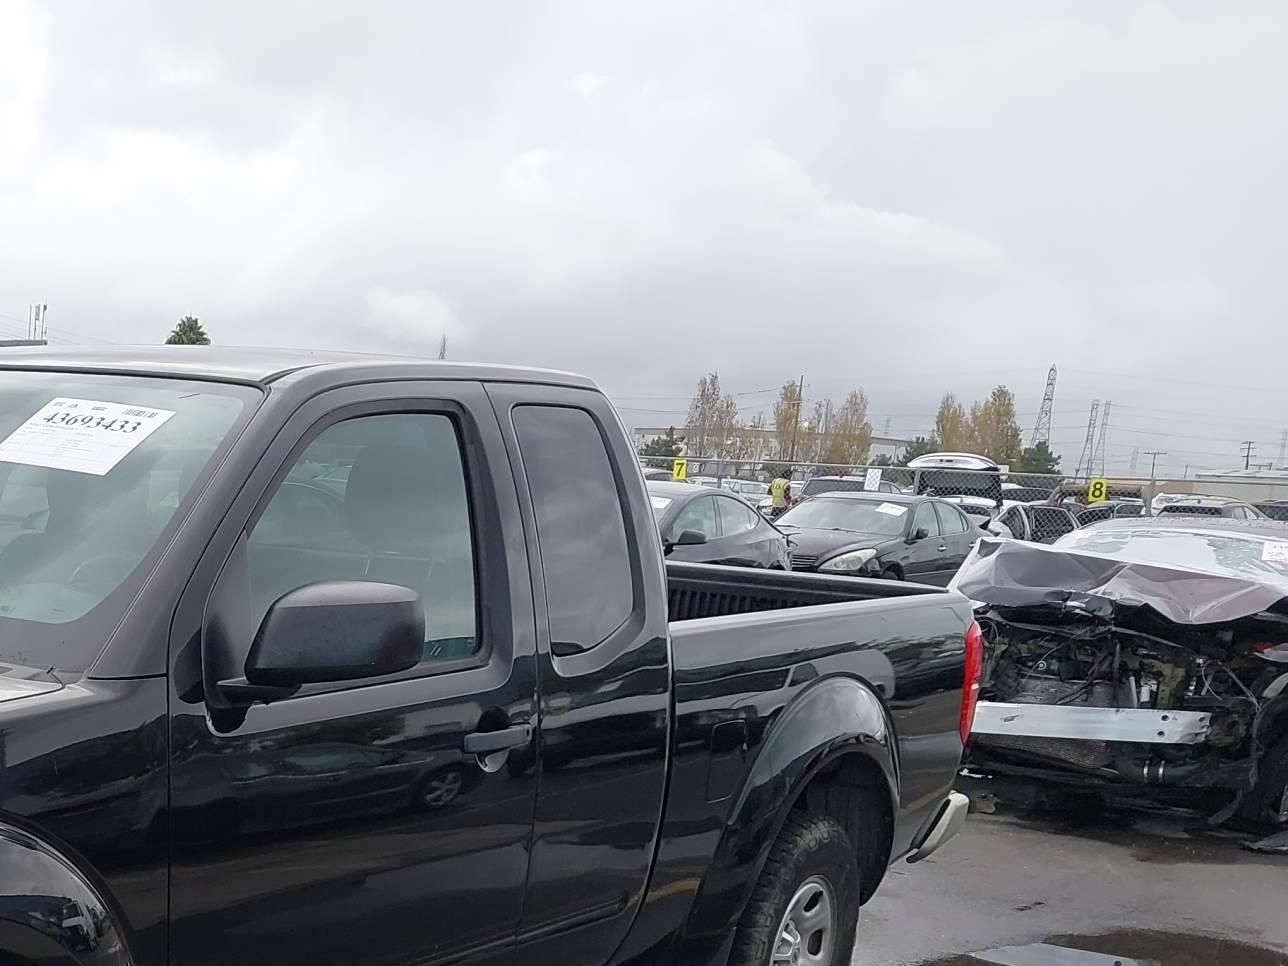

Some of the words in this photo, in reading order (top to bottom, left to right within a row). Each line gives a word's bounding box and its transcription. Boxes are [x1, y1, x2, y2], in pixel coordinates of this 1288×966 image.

[43, 412, 142, 433] 43693433
[675, 462, 685, 477] 7
[1092, 481, 1104, 498] 8
